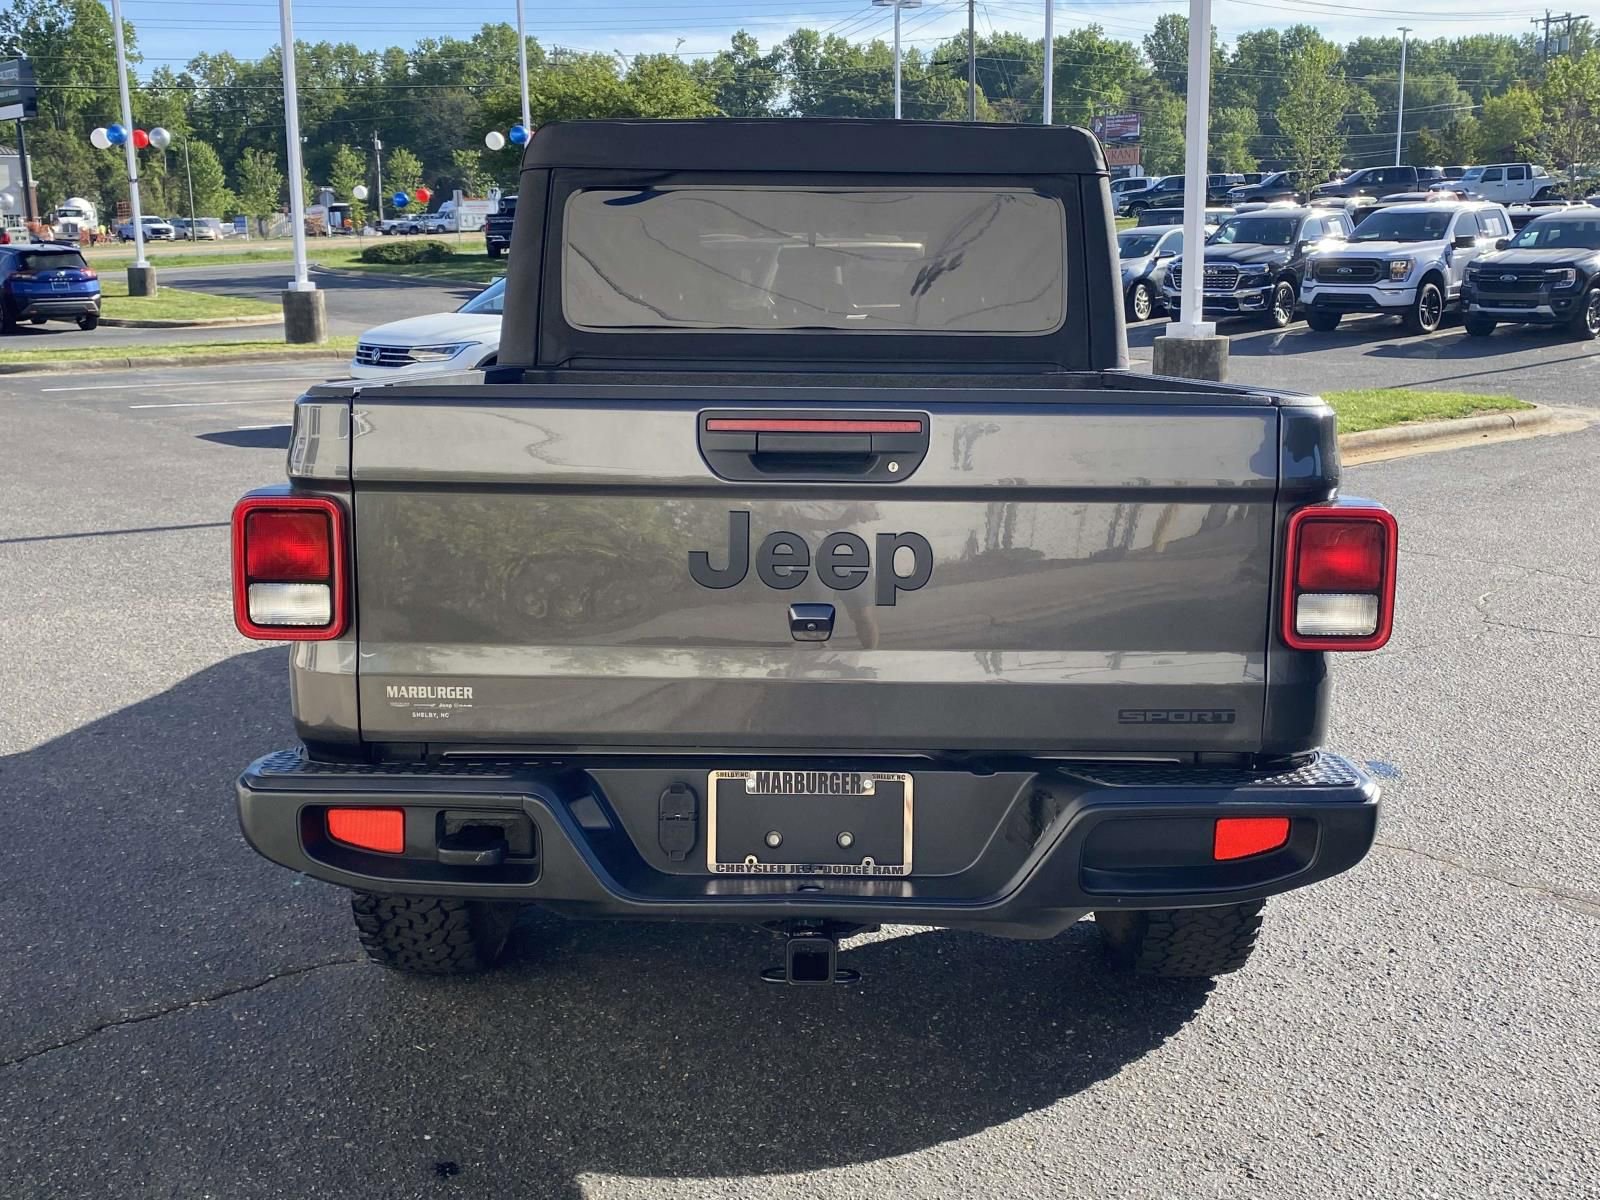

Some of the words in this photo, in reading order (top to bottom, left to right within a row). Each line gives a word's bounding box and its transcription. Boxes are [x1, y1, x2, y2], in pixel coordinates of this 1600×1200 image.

[688, 510, 934, 607] Jeep
[386, 686, 473, 699] MARBURGER
[1118, 709, 1236, 724] SPORT
[755, 772, 862, 794] MARBURGER
[715, 864, 787, 873] CHRYSLER
[823, 865, 870, 875] DODGE
[872, 866, 904, 875] RAM
